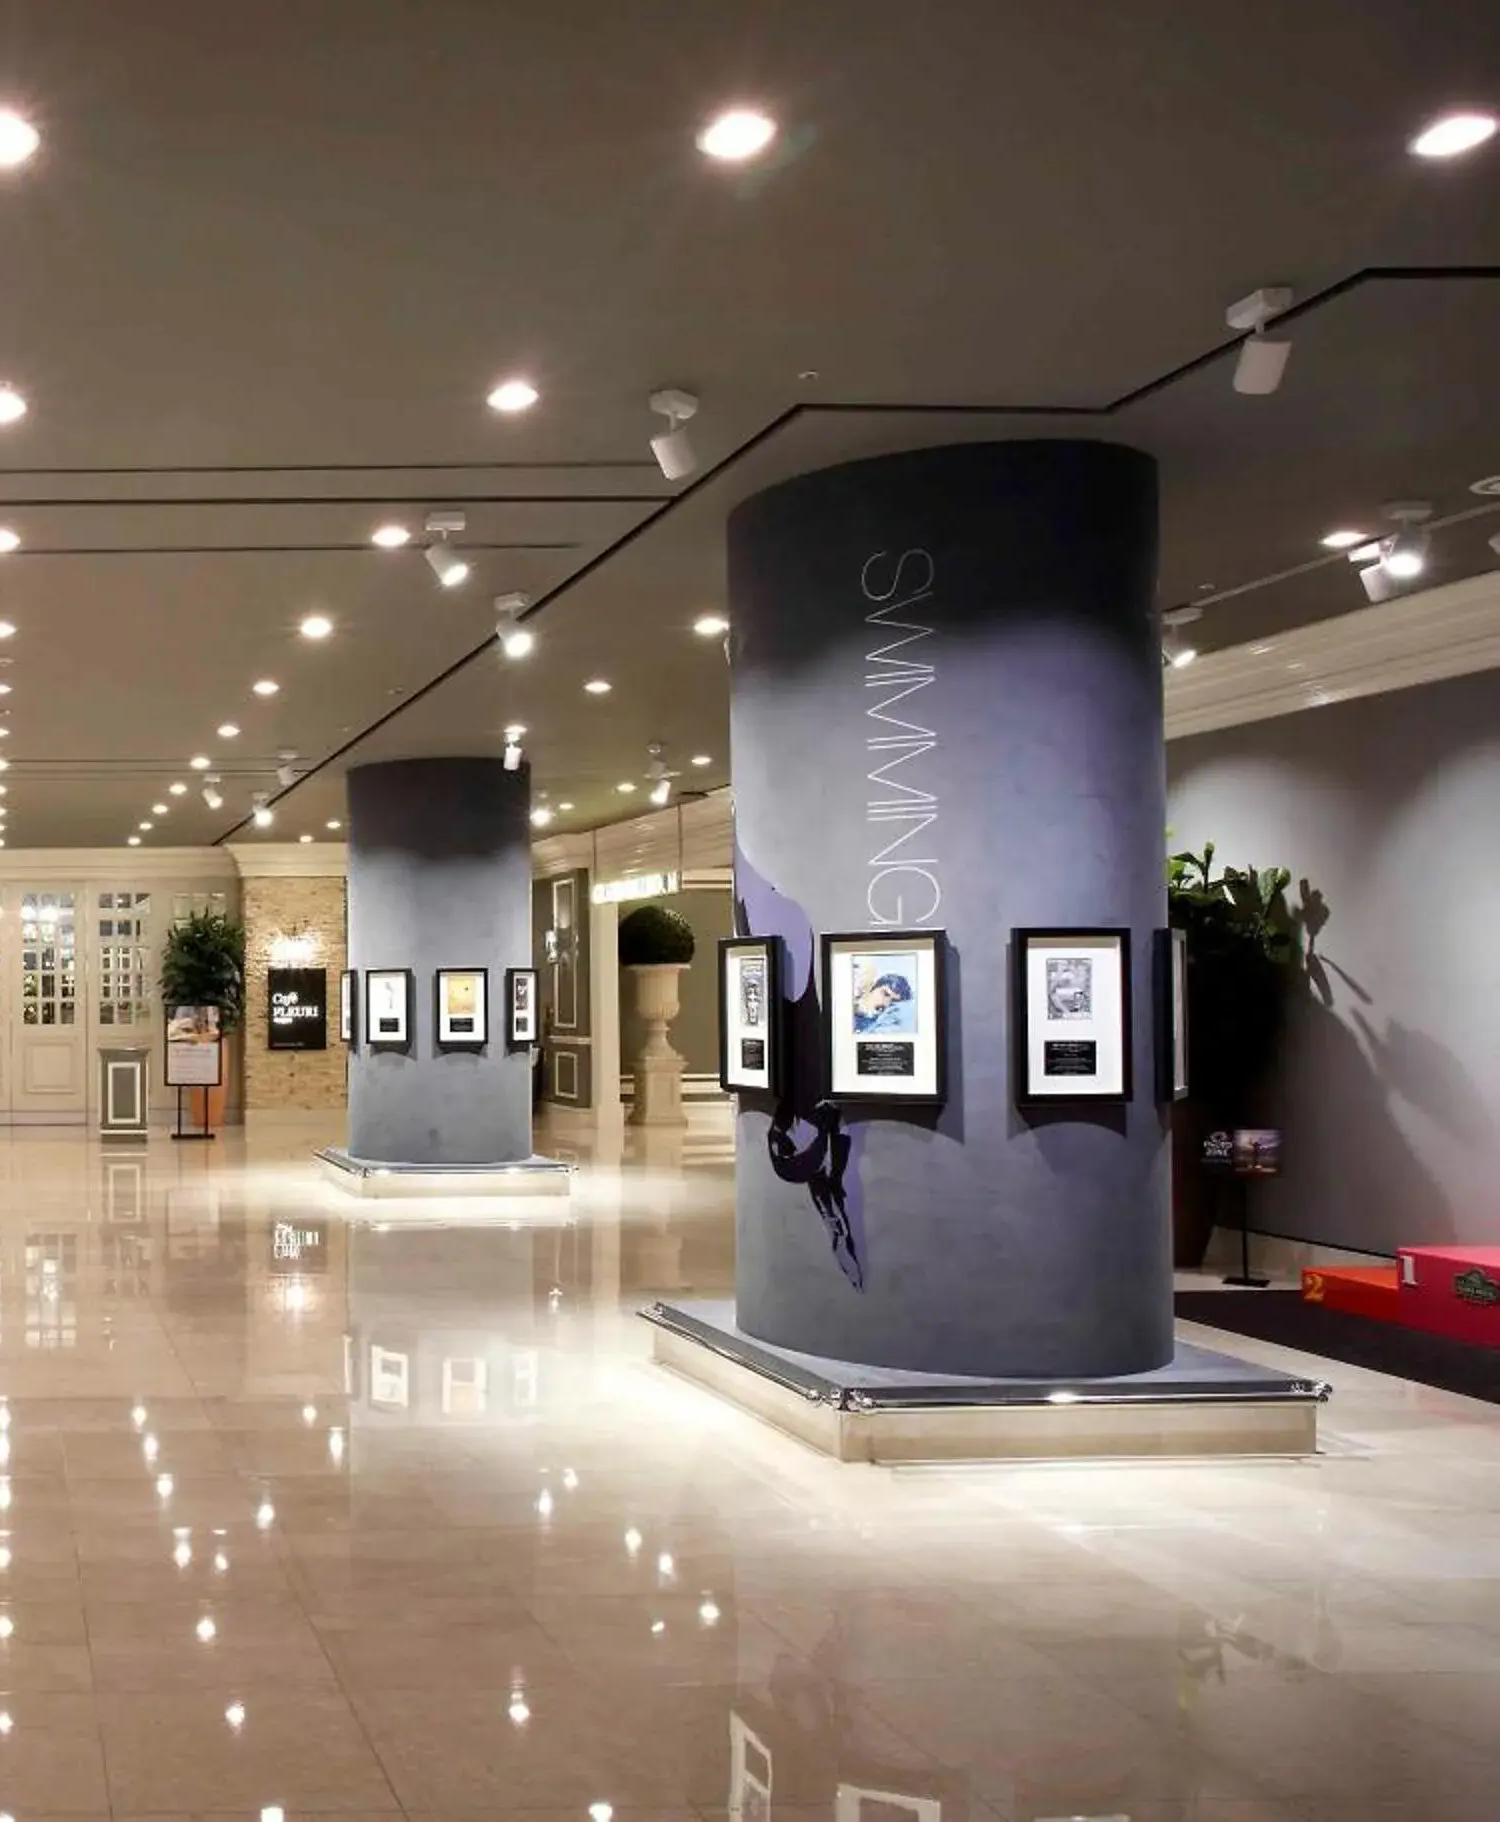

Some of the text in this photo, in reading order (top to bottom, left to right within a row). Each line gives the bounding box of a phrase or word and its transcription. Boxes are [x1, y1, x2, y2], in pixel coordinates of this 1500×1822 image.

[861, 548, 942, 926] SWIMMING
[1400, 1255, 1419, 1286] 1
[1303, 1274, 1324, 1302] 2
